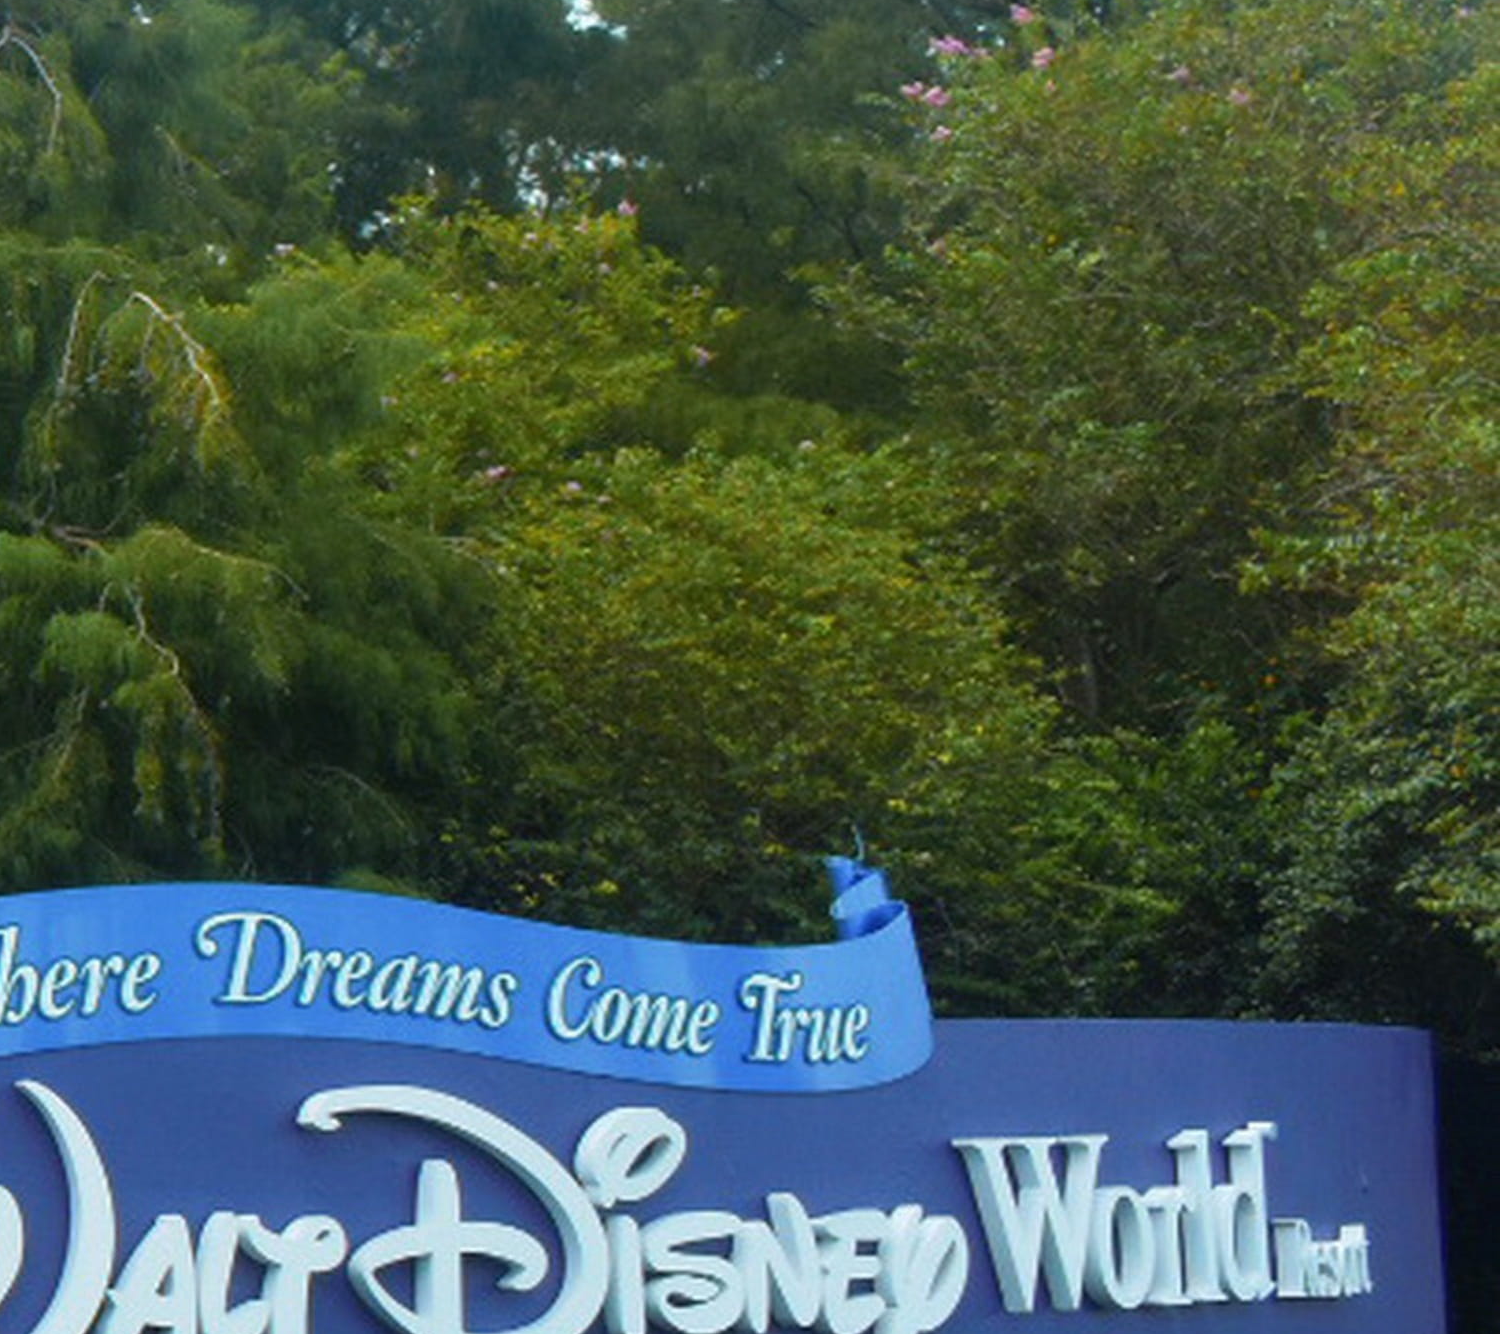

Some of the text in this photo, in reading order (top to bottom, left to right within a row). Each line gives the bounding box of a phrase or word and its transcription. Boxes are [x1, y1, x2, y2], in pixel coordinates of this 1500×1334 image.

[195, 911, 516, 1027] Dreams
[547, 957, 719, 1053] Come
[739, 973, 871, 1063] True
[951, 1121, 1277, 1312] World
